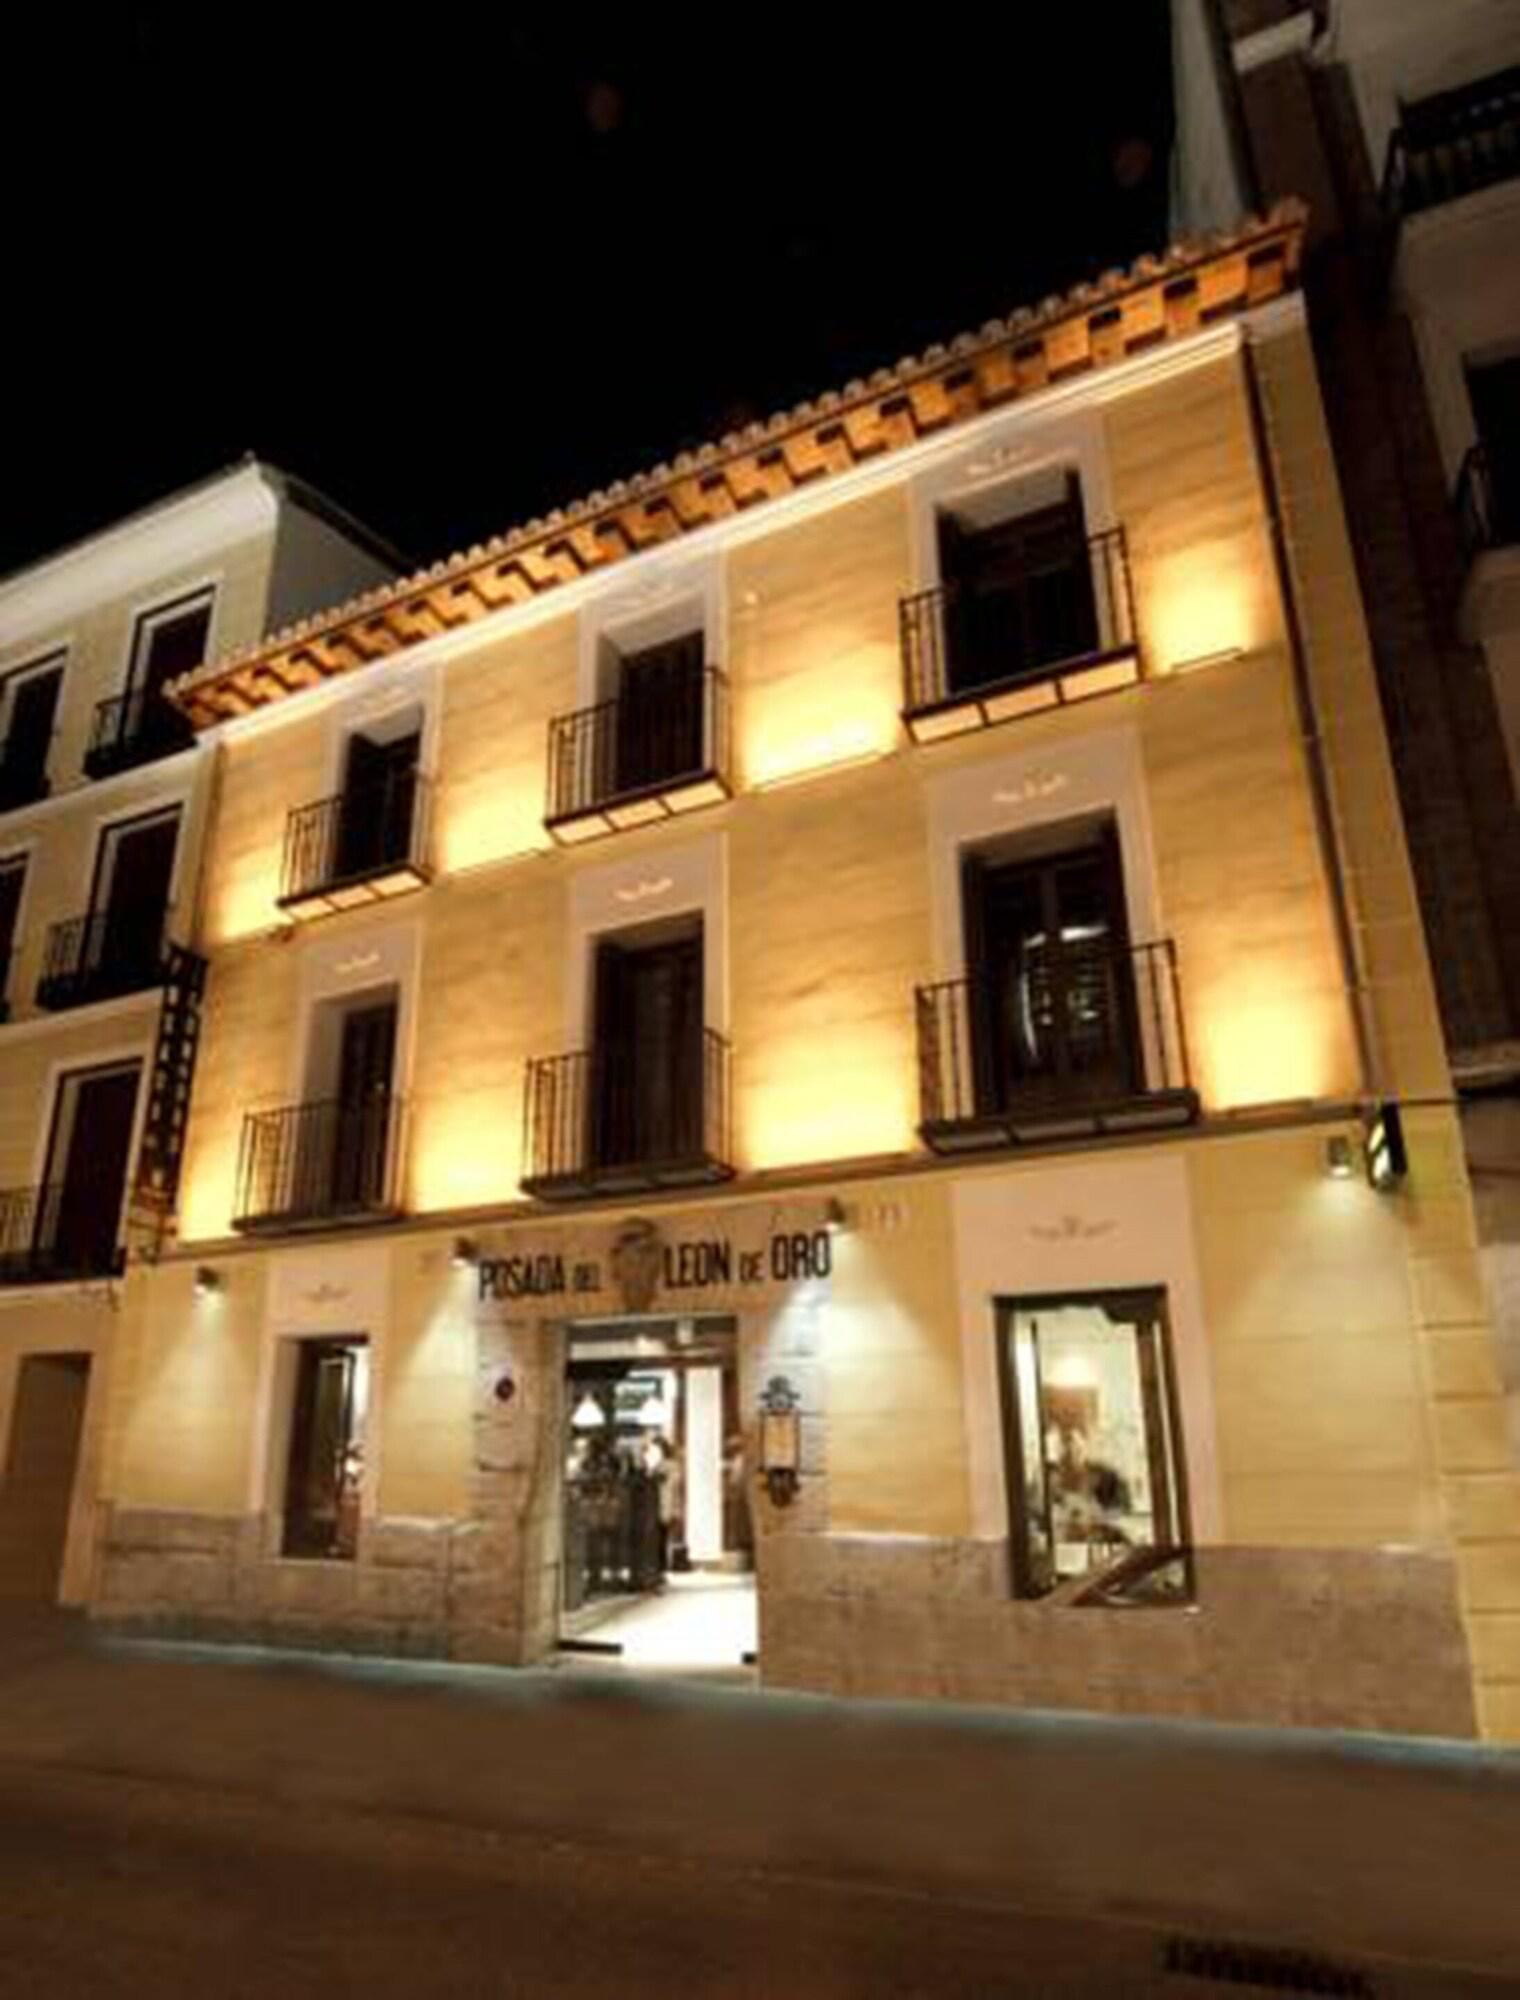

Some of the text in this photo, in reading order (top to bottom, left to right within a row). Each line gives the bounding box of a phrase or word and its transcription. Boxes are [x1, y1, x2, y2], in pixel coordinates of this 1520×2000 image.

[478, 1254, 565, 1301] POSADA
[663, 1239, 731, 1291] LEON
[739, 1250, 767, 1284] DE
[771, 1230, 832, 1281] ORO
